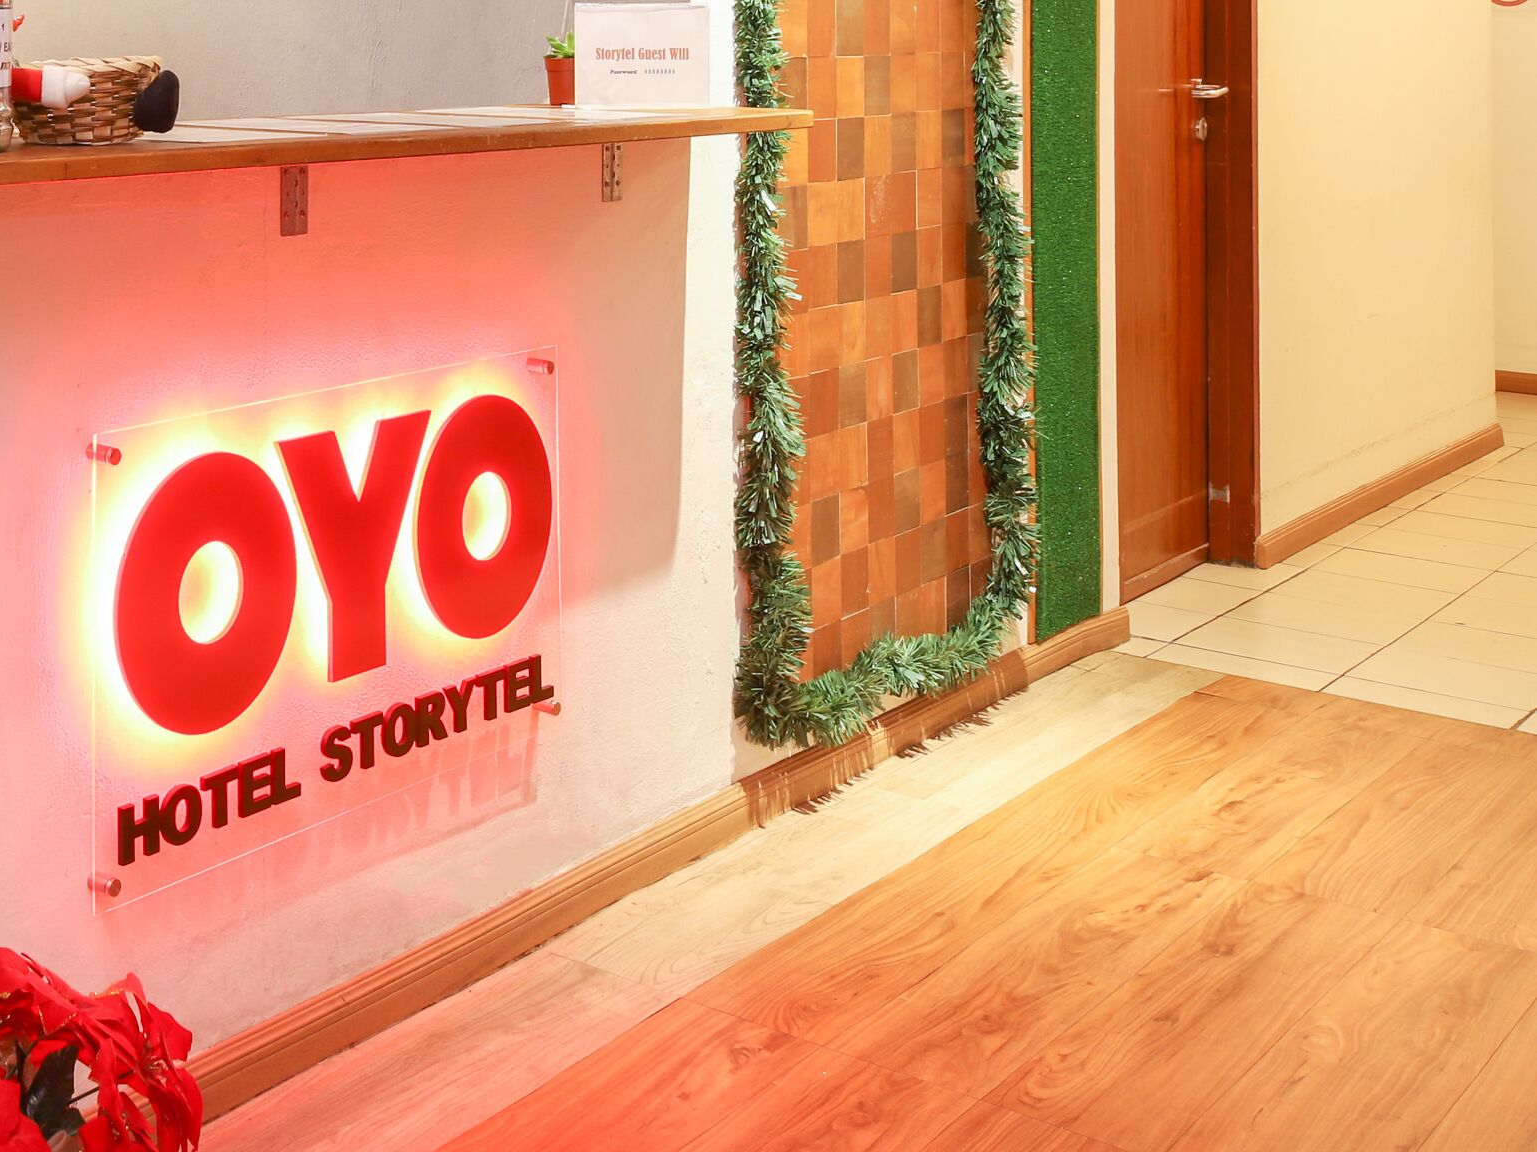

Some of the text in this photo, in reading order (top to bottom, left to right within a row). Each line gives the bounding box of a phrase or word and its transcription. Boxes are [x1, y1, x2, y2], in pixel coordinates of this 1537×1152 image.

[1, 23, 5, 31] 1
[595, 47, 635, 61] Storytel
[638, 47, 666, 60] Guest
[113, 394, 552, 736] OYO
[117, 654, 554, 866] HOTEL STORYTEL
